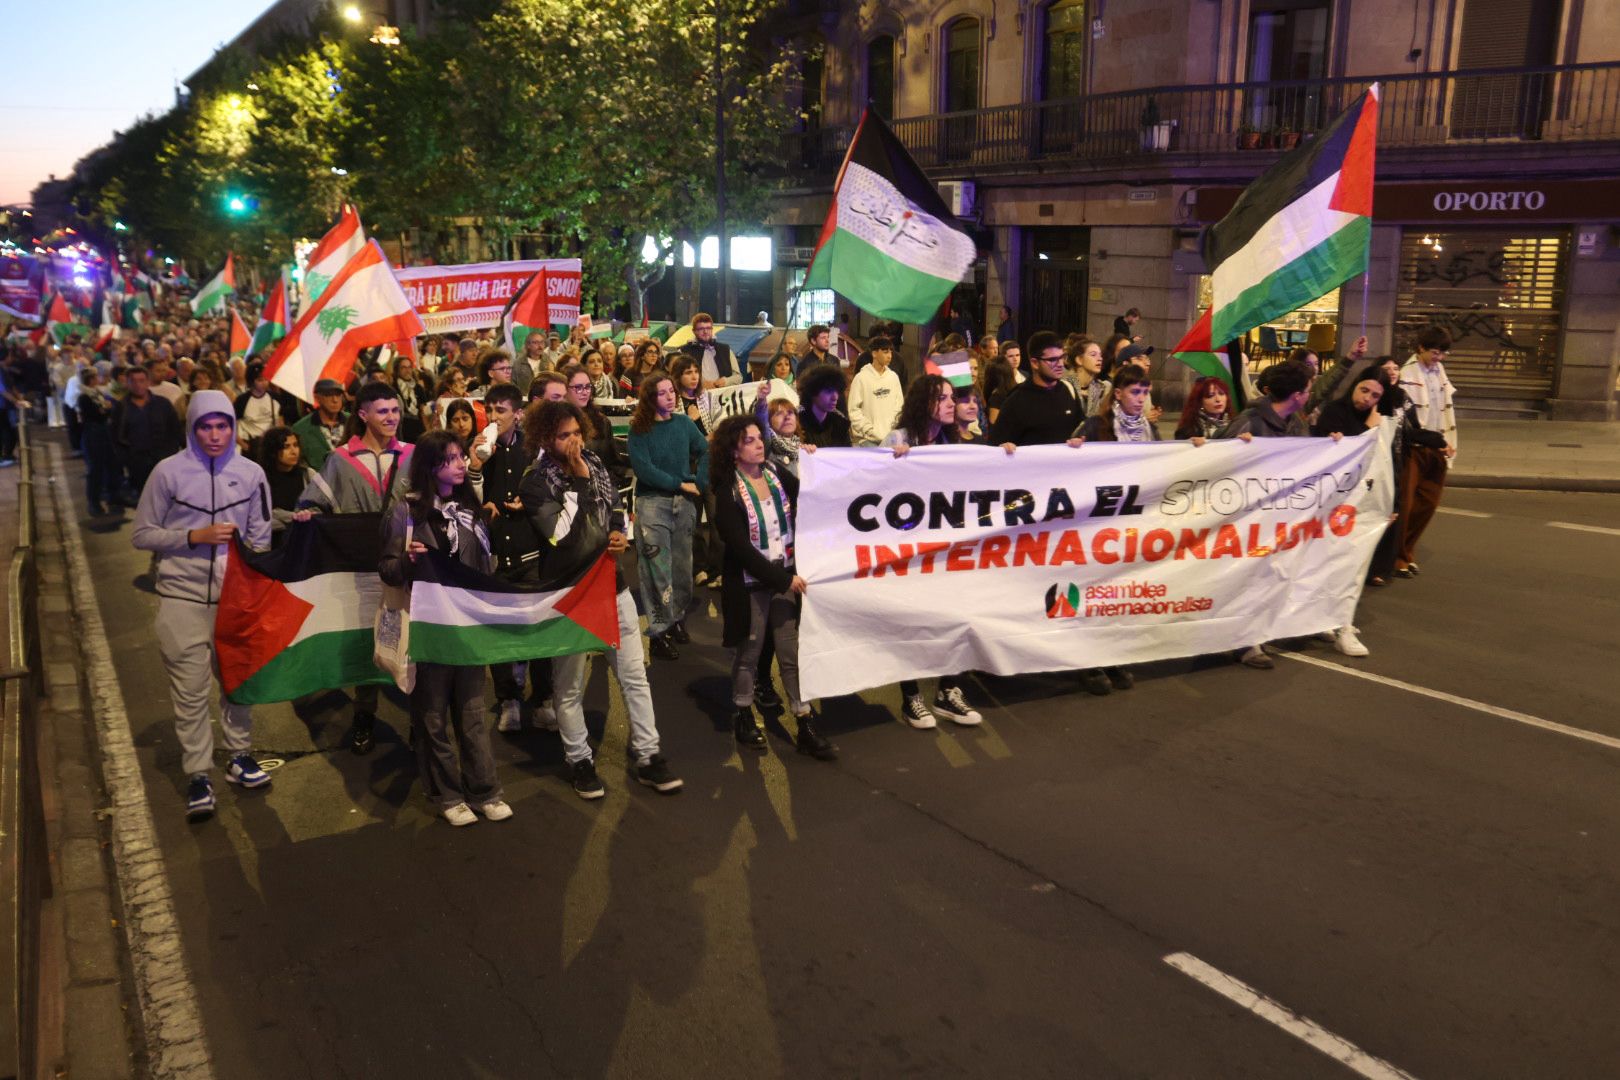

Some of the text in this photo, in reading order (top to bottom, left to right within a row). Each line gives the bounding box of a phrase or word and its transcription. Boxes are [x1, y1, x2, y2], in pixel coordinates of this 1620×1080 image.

[1433, 190, 1545, 211] OPORTO
[427, 284, 443, 305] LA
[447, 280, 488, 303] TUMBA
[491, 279, 512, 299] DEL
[847, 487, 1076, 533] CONTRA
[1089, 484, 1144, 518] EL
[855, 503, 1357, 579] INTERNACIONALISMO
[1085, 580, 1167, 600] asamblea
[1085, 596, 1214, 618] internacionalista
